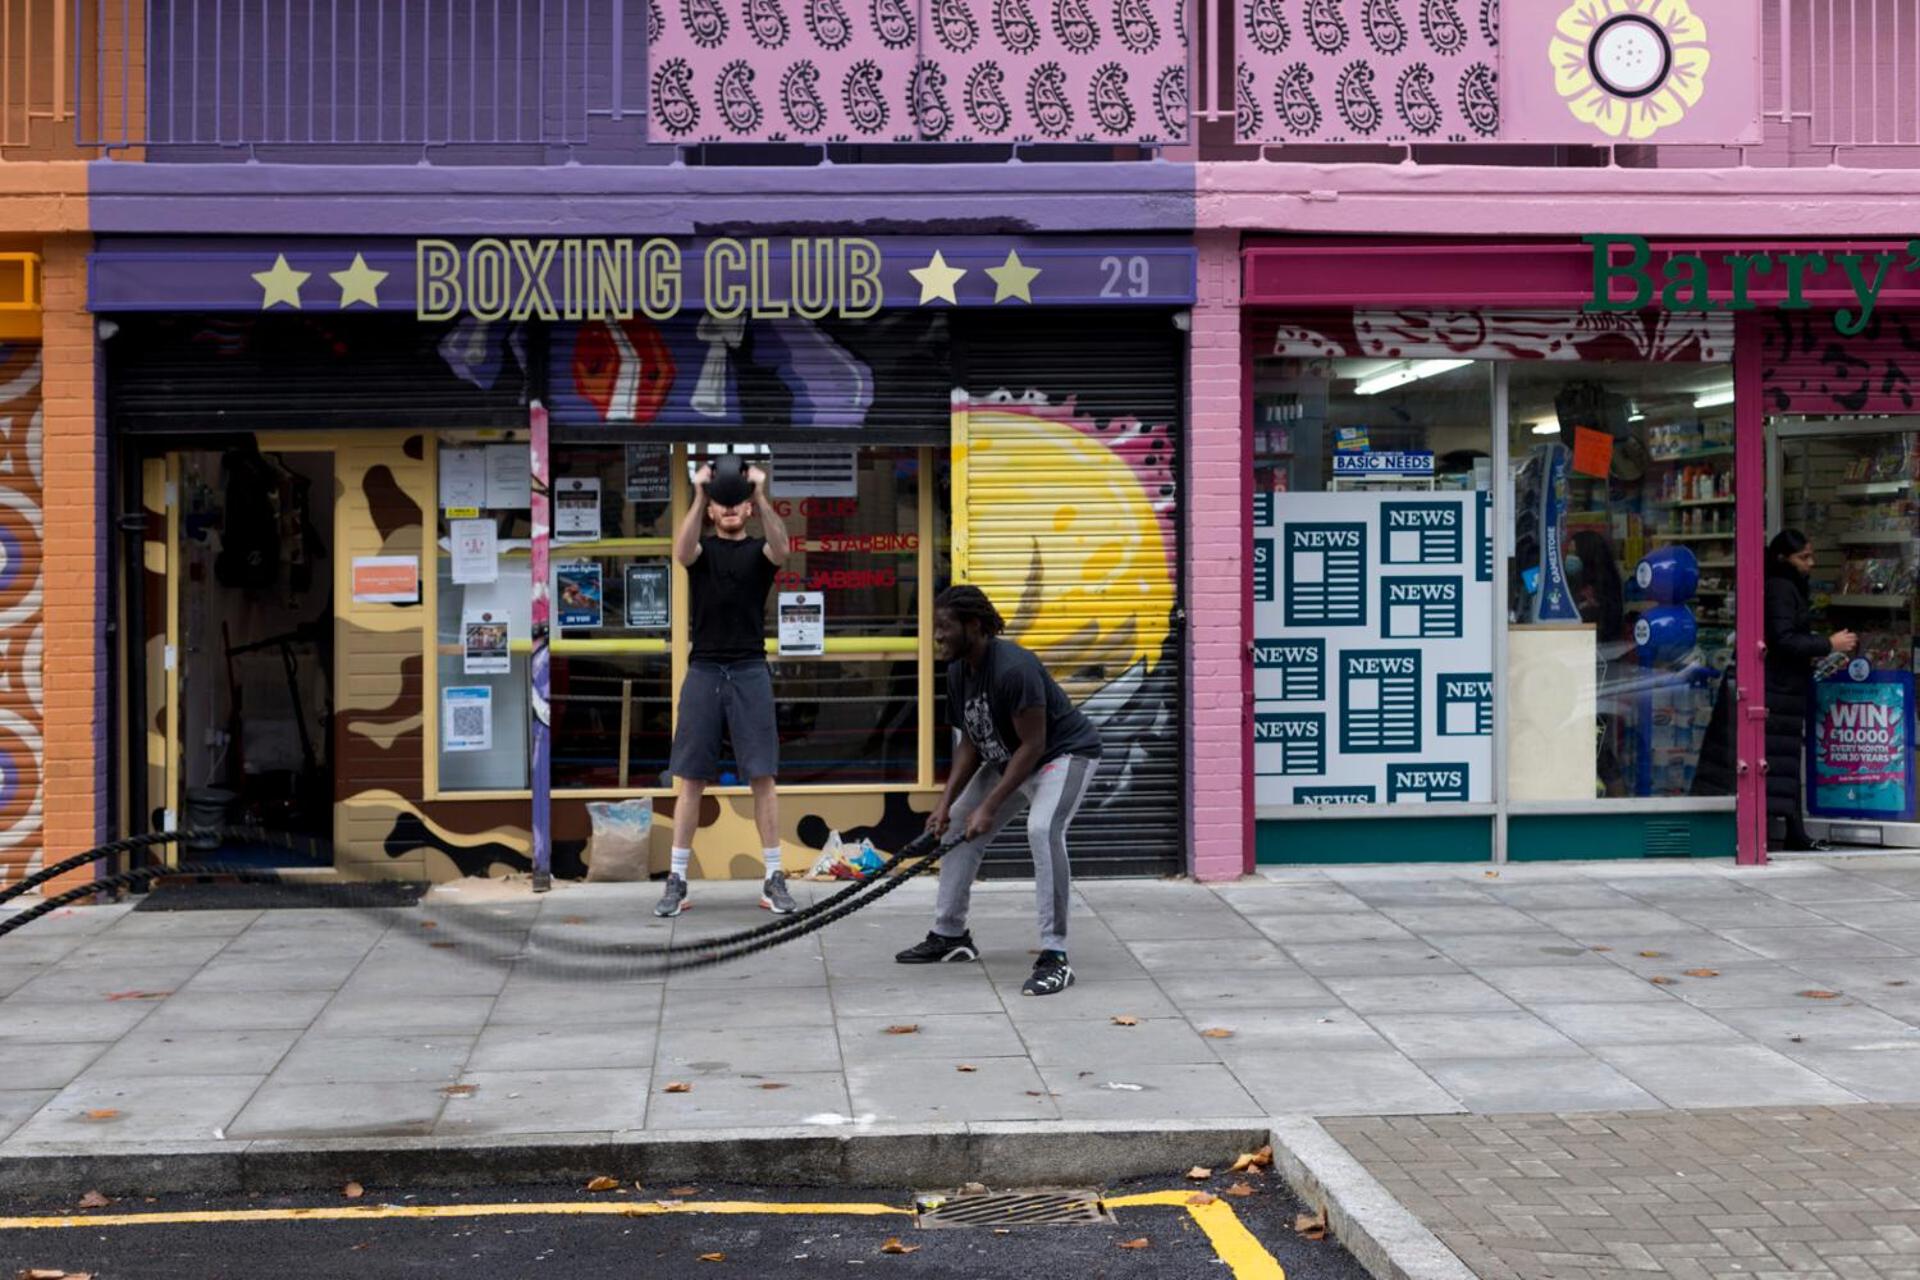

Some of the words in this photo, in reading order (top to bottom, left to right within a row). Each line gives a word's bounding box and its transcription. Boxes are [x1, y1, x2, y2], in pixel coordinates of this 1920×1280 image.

[416, 239, 682, 321] BOXING
[704, 238, 884, 319] CLUB
[1100, 256, 1149, 298] 29
[1337, 456, 1380, 468] BASIC
[1385, 456, 1431, 468] NEEDS
[1389, 510, 1456, 526] NEWS
[820, 532, 919, 553] STABBING
[1293, 531, 1360, 547] NEWS
[808, 567, 895, 591] JABBING
[1389, 584, 1456, 600] NEWS
[1254, 647, 1319, 663] NEWS
[1348, 657, 1415, 674] NEWS
[1446, 682, 1492, 697] NEW
[1829, 704, 1888, 728] WIN
[1254, 721, 1319, 737] NEWS
[1396, 771, 1463, 788] NEWS
